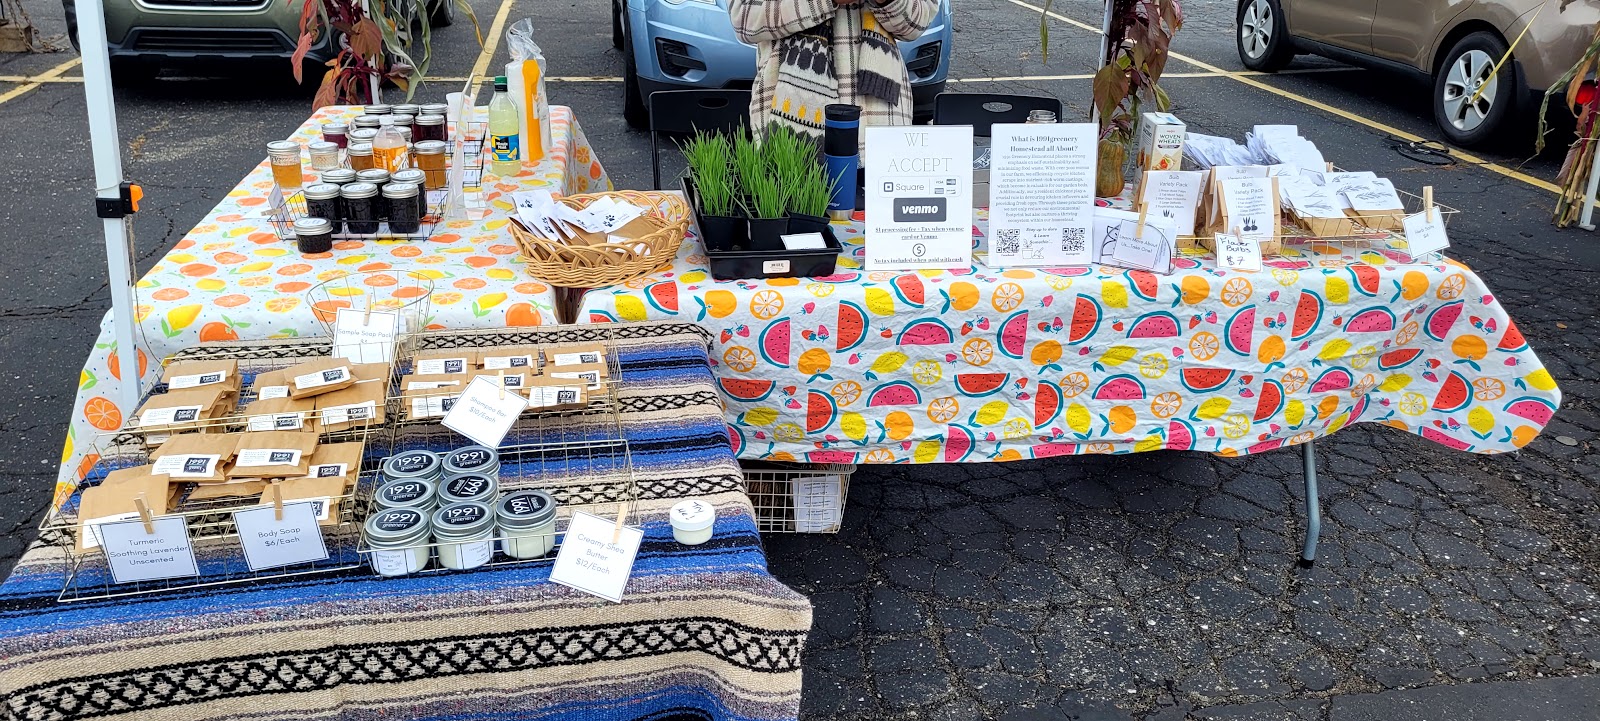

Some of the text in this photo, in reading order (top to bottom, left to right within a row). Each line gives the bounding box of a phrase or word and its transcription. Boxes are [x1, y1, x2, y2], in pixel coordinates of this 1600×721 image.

[904, 133, 928, 146] WE
[888, 158, 952, 172] ACCEPT
[896, 184, 924, 192] Square
[902, 206, 938, 214] venmo
[470, 397, 496, 412] Shampoo
[469, 407, 496, 423] $10/Each
[397, 456, 427, 466] 1991
[456, 451, 484, 462] 1991
[389, 484, 419, 494] 1991
[461, 479, 485, 496] 1991
[511, 498, 530, 514] 1991
[383, 513, 416, 522] 1991
[447, 507, 478, 518] 1991
[258, 526, 301, 538] Body Soap
[265, 536, 300, 547] $6/Each
[577, 533, 625, 555] Creamy Shea
[110, 545, 188, 558] Soothing Lavender
[586, 548, 608, 562] Butter
[129, 556, 174, 565] Unscented
[575, 557, 611, 575] $12/Each
